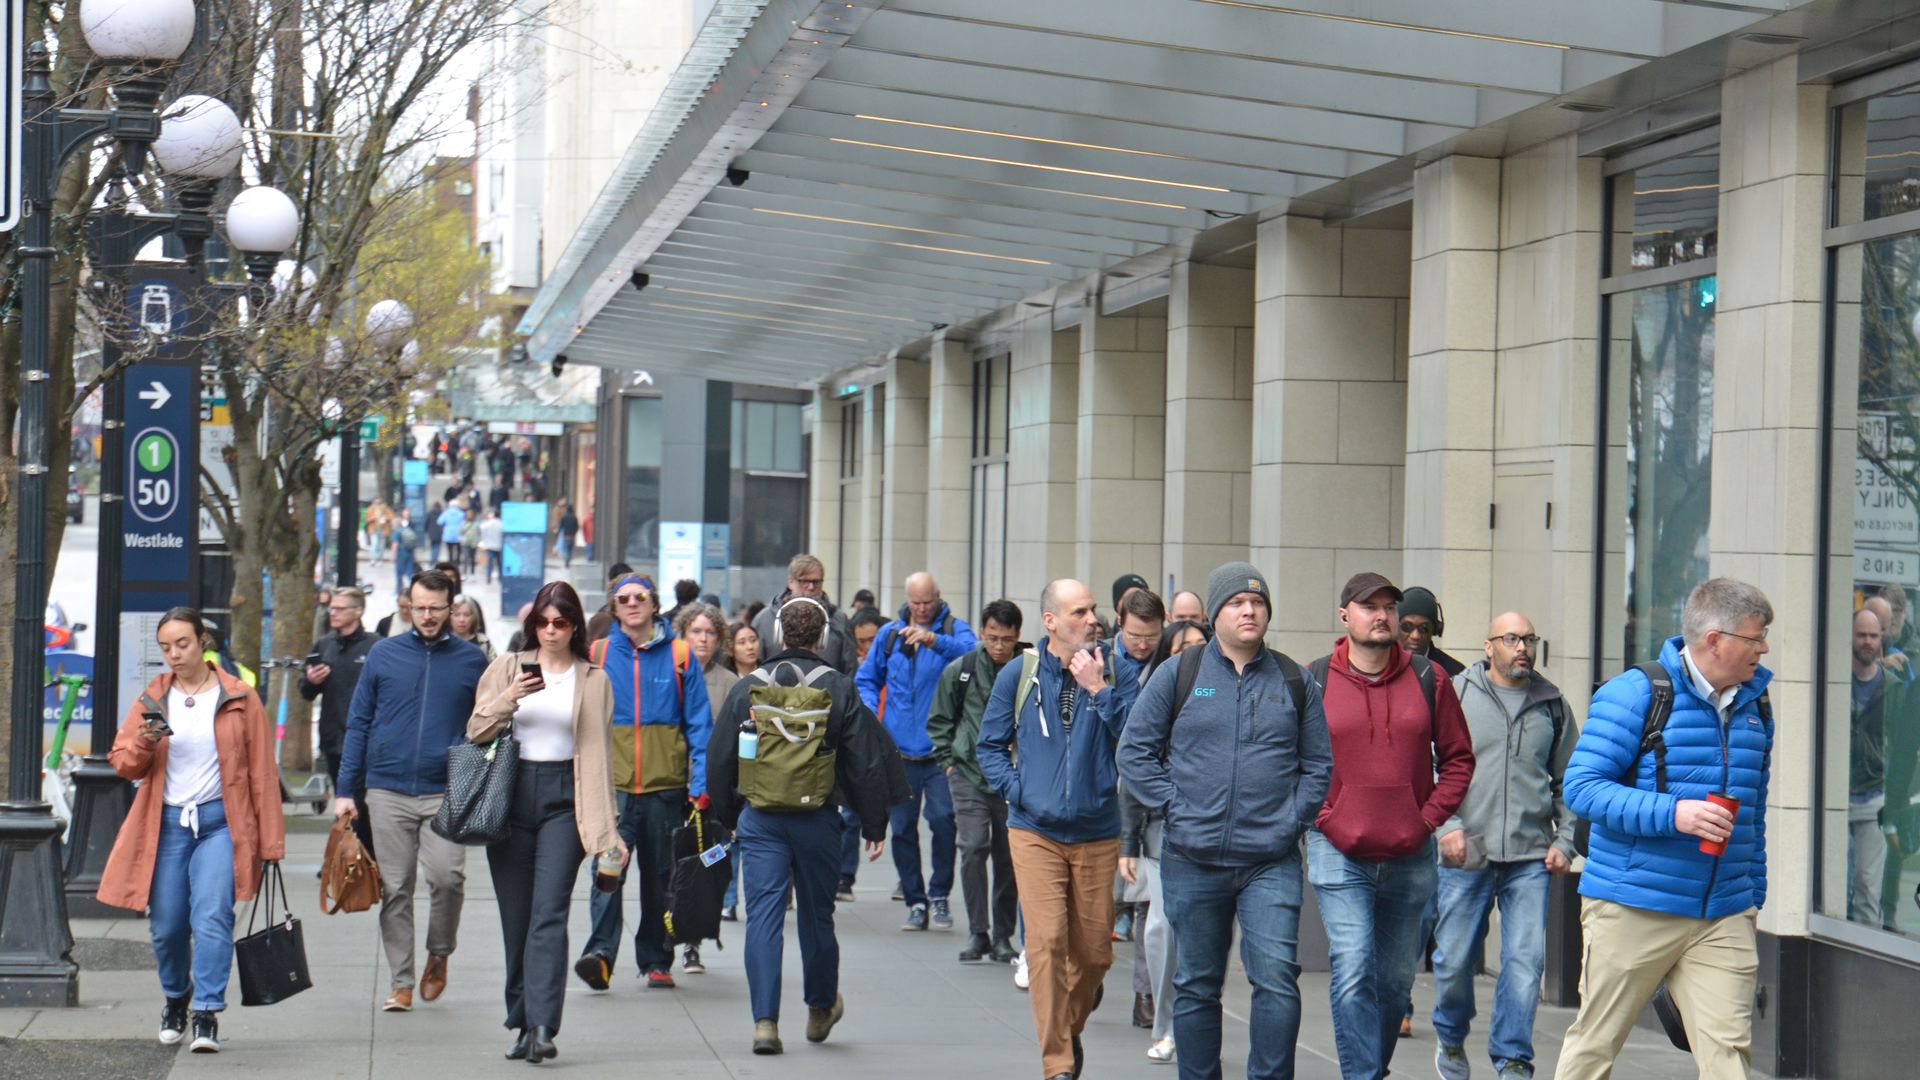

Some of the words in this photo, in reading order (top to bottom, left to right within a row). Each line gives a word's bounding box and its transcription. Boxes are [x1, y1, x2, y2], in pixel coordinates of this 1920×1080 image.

[147, 441, 160, 467] 1
[138, 479, 171, 506] 50
[124, 532, 184, 548] Westlake
[1194, 687, 1217, 697] GSF
